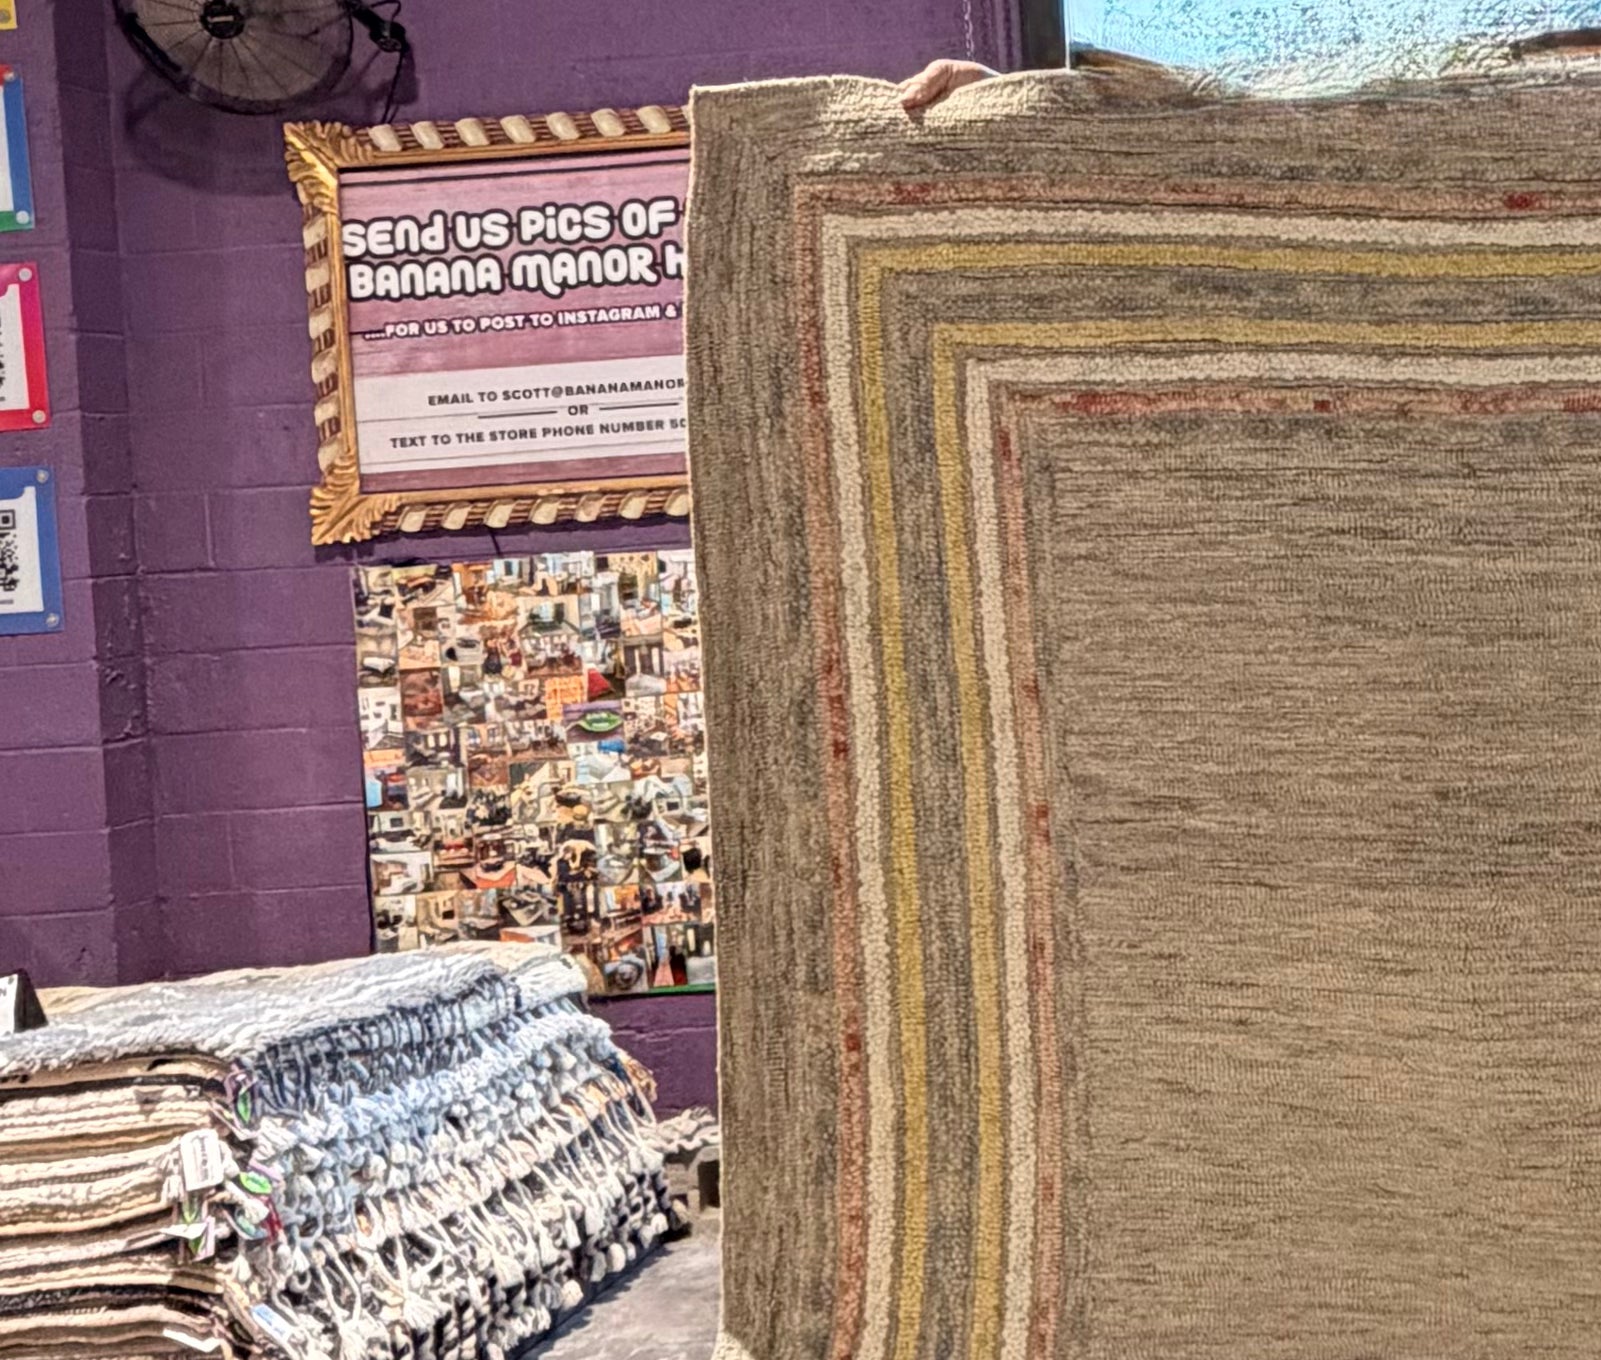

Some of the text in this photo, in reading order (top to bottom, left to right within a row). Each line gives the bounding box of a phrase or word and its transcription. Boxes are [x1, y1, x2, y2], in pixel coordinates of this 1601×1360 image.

[453, 211, 511, 249] US
[620, 199, 677, 237] OF
[348, 256, 503, 299] BANANA
[511, 246, 659, 296] MANOR
[423, 320, 449, 335] US
[452, 318, 475, 333] TO
[479, 315, 525, 331] POST
[530, 313, 553, 326] TO
[557, 305, 661, 325] INSTAGRAM
[665, 304, 677, 317] &
[428, 393, 474, 406] EMAIL
[478, 390, 498, 402] TO
[567, 404, 589, 416] OR
[390, 435, 427, 448] TEXT
[431, 434, 452, 445] TO
[456, 431, 485, 444] THE
[489, 428, 537, 441] STORE
[542, 424, 594, 438] PHONE
[599, 420, 664, 434] NUMBER
